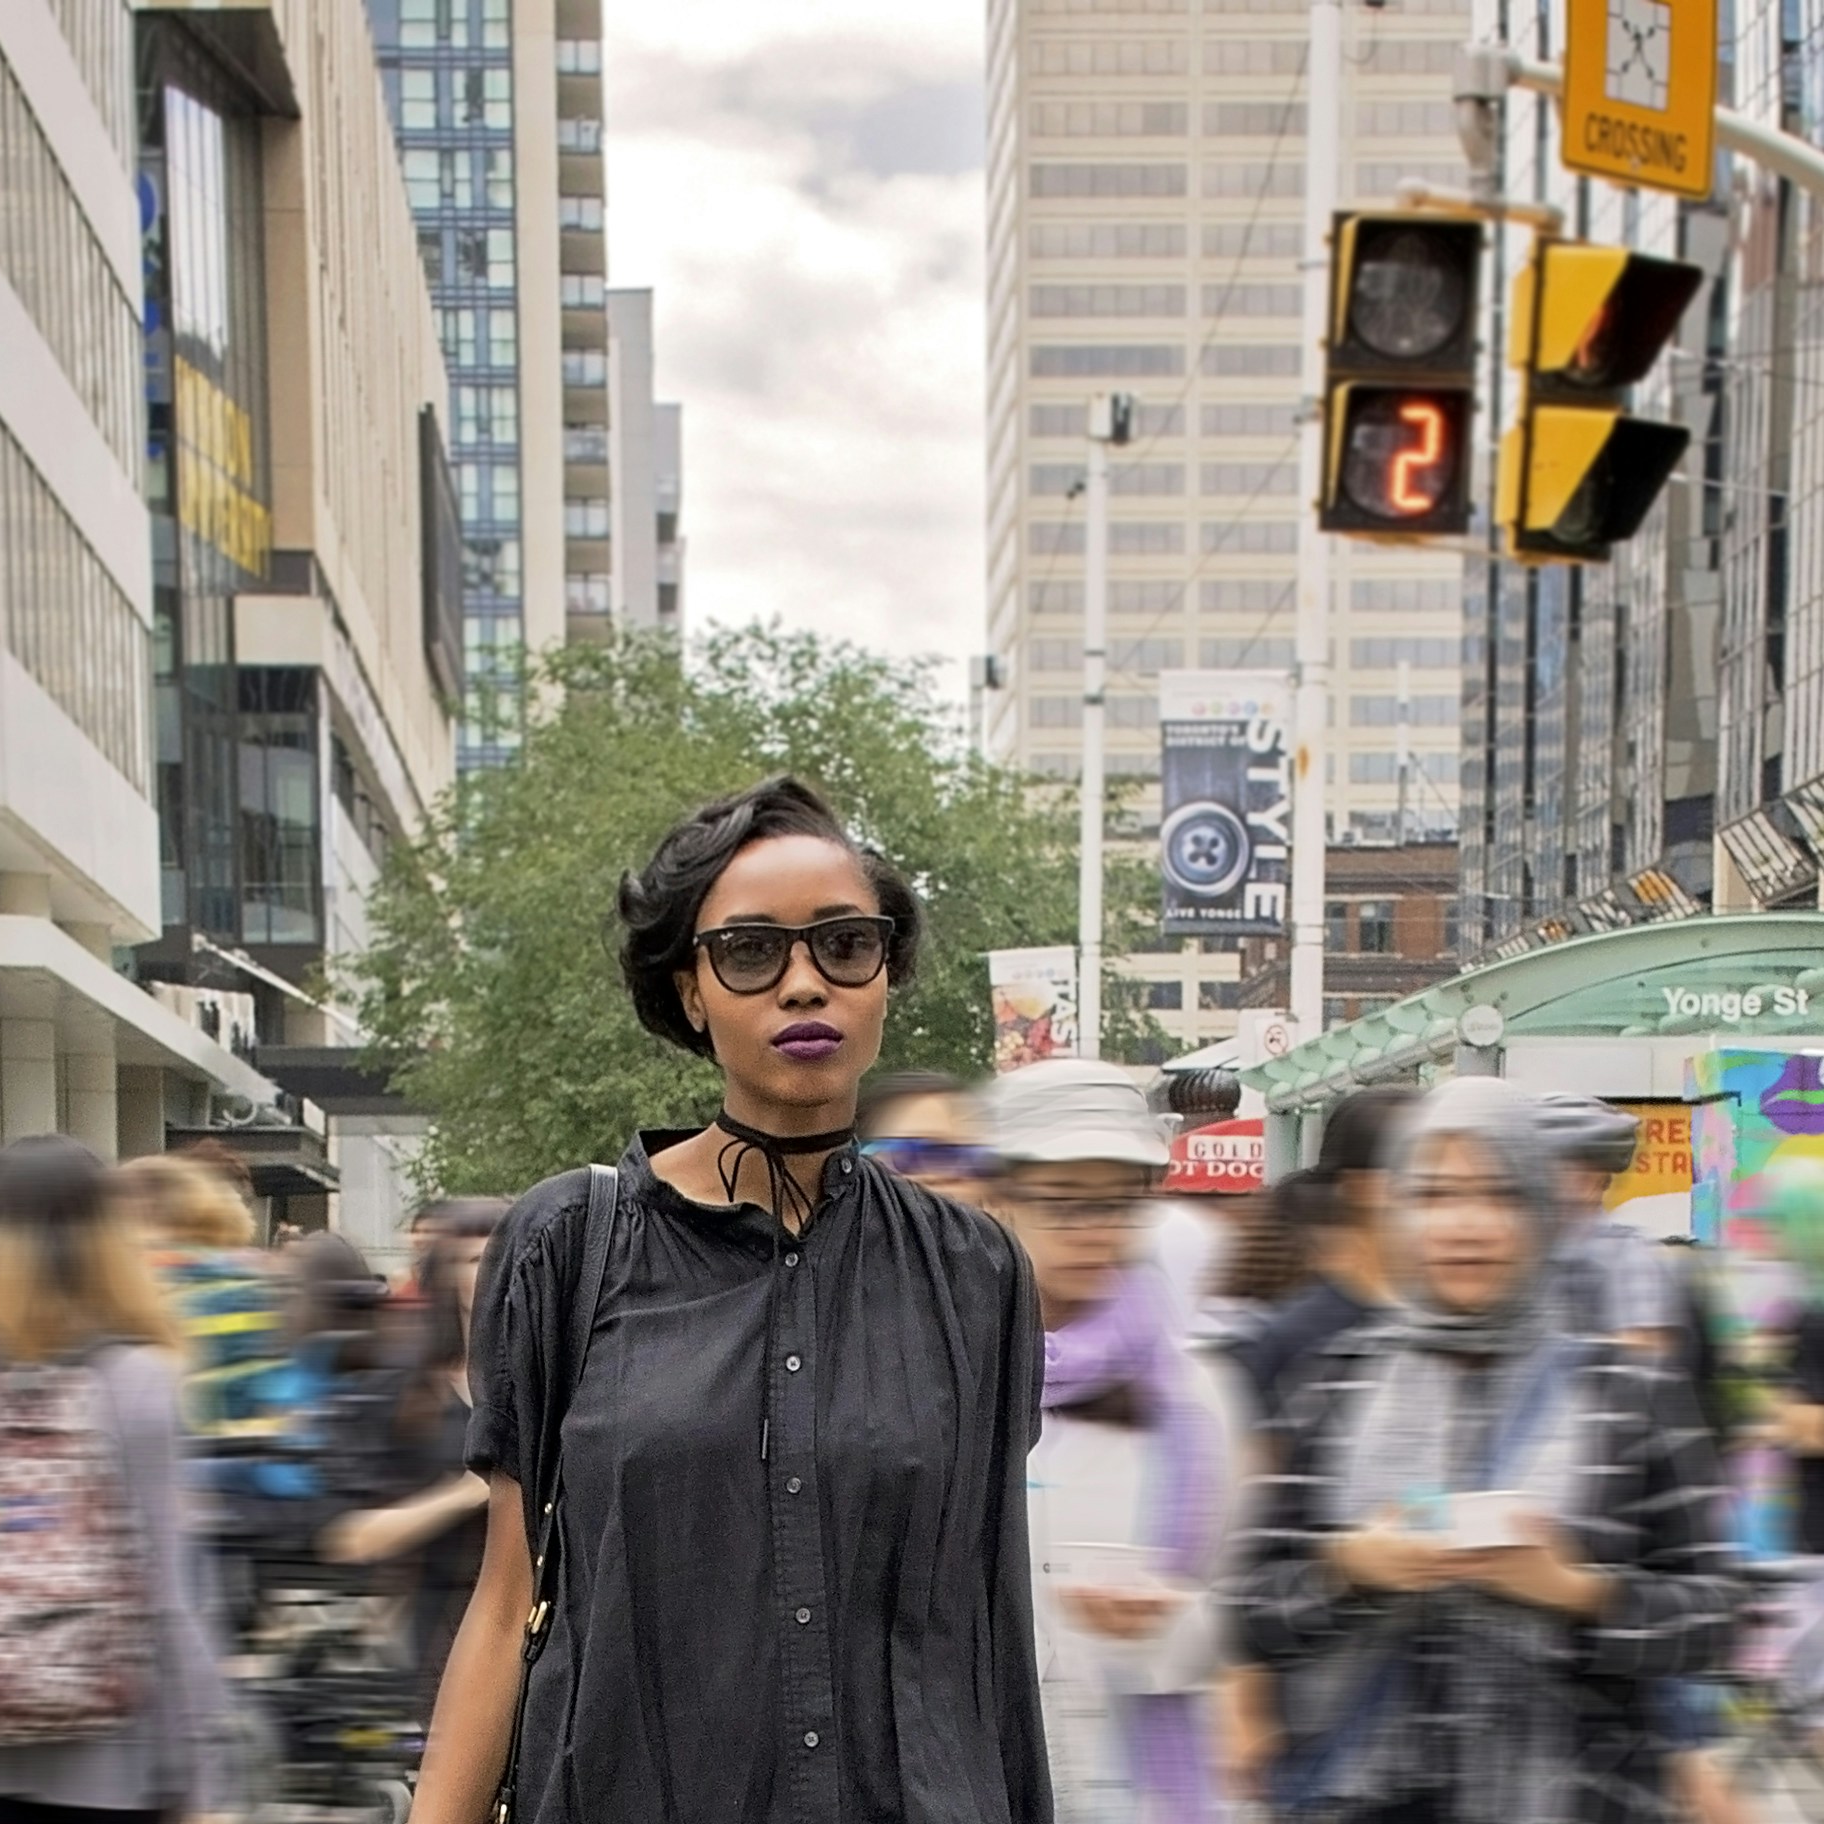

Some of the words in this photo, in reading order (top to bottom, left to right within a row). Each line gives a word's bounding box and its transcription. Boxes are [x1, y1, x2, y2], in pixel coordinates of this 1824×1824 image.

[1584, 111, 1688, 174] CROSSING
[1393, 402, 1442, 514] 2
[1242, 714, 1293, 920] STYLE
[1662, 986, 1762, 1022] Yonge
[1773, 986, 1810, 1016] St
[1169, 1160, 1198, 1176] OT
